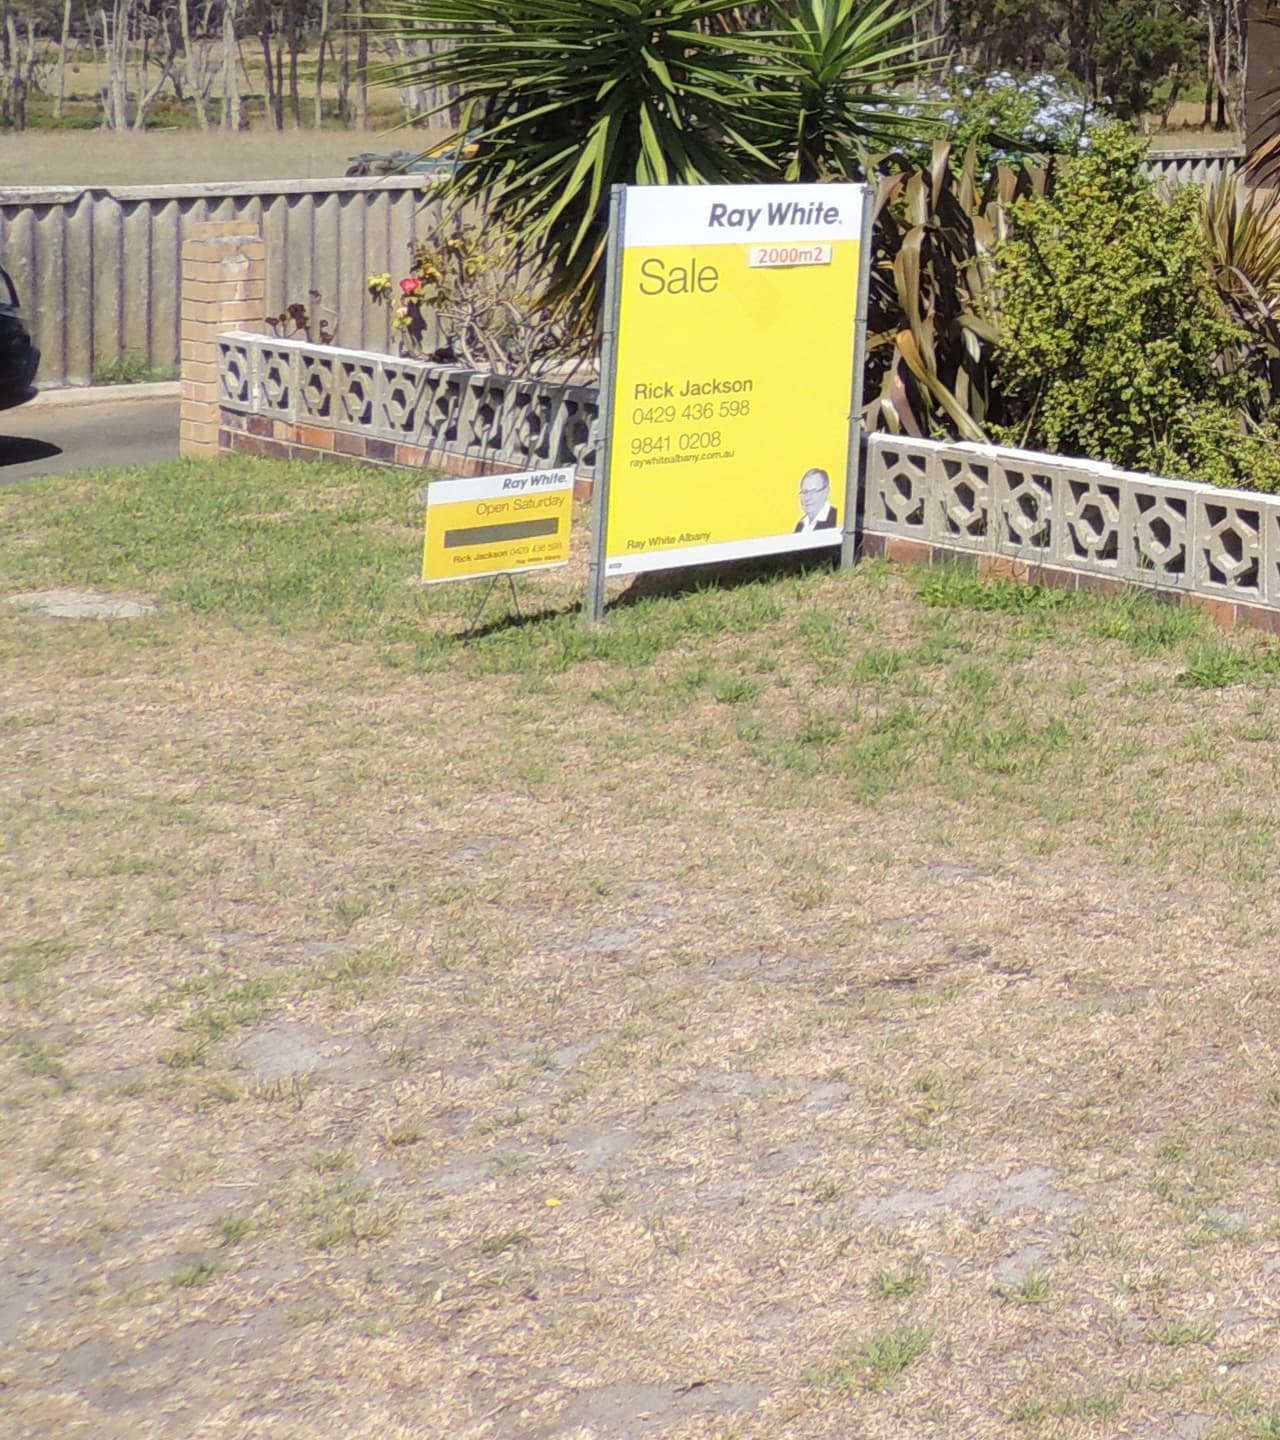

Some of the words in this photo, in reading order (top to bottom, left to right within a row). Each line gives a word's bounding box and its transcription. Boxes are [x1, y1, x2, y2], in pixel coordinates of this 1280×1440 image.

[708, 203, 762, 231] Ray
[758, 246, 823, 264] 2000m2
[639, 258, 719, 296] Sale
[634, 382, 674, 400] Rick
[679, 378, 753, 397] Jackson
[632, 405, 675, 425] 0429
[681, 402, 714, 420] 436
[719, 400, 750, 418] 598
[631, 435, 671, 455] 9841
[679, 430, 721, 450] 0208
[630, 450, 735, 469] raywhitealbany.com.au
[502, 478, 527, 490] Ray
[476, 502, 509, 516] Open
[513, 496, 565, 511] Saturday
[626, 540, 645, 550] Ray
[648, 536, 676, 547] White
